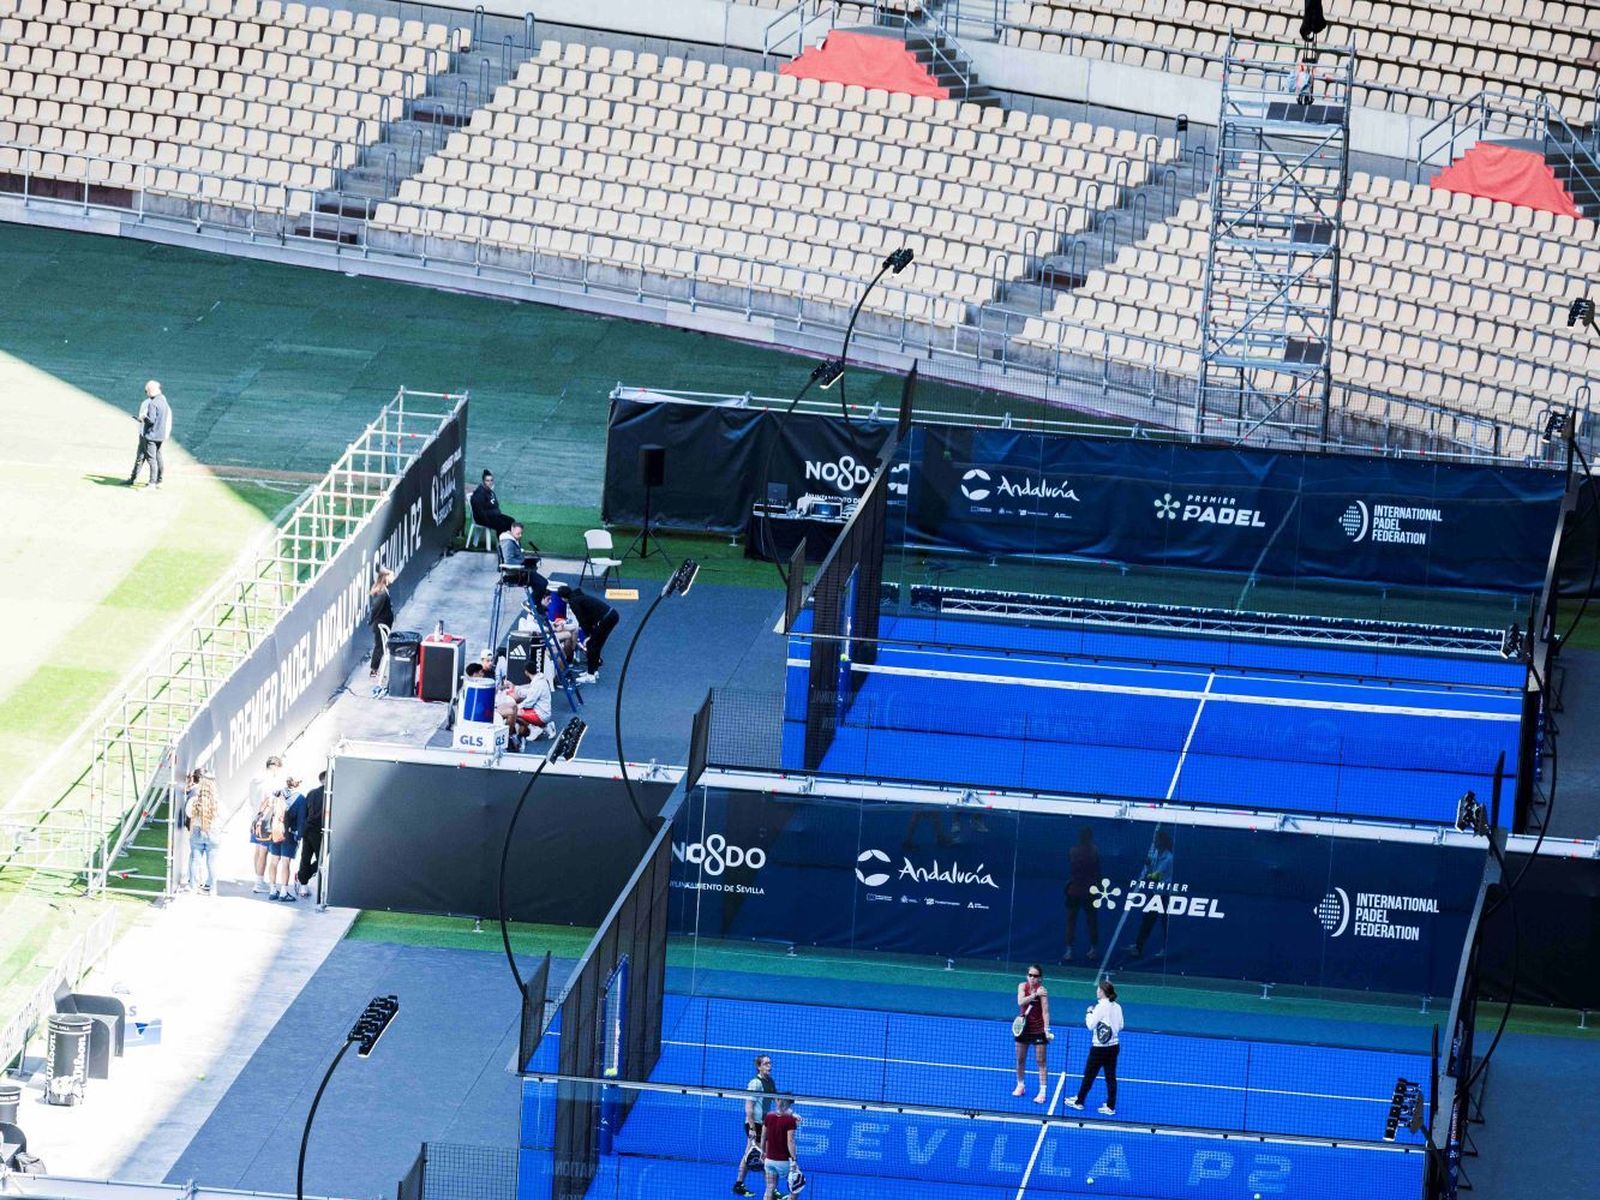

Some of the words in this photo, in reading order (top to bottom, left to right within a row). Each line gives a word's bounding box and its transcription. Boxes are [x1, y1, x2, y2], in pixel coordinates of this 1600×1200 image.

[997, 475, 1080, 502] Andalucía
[1187, 494, 1236, 505] PREMIER
[1182, 505, 1266, 528] PADEL
[1373, 504, 1443, 522] INTERNATIONAL
[1372, 517, 1401, 531] PADEL
[1372, 529, 1426, 545] FEDERATION
[229, 676, 280, 779] PREMIER
[279, 630, 312, 719] PADEL
[313, 549, 371, 677] ANDALUCÍA
[410, 496, 422, 558] P2
[460, 734, 484, 748] GLS
[898, 856, 999, 889] Andalucía
[724, 884, 734, 893] DE
[735, 884, 765, 895] SEVILLA
[1130, 879, 1189, 893] PREMIER
[1124, 892, 1225, 919] PADEL
[1356, 892, 1440, 914] INTERNATIONAL
[1355, 907, 1389, 924] PADEL
[1354, 921, 1420, 941] FEDERATION
[796, 1114, 1131, 1181] SEVILLA
[1188, 1149, 1292, 1194] P2
